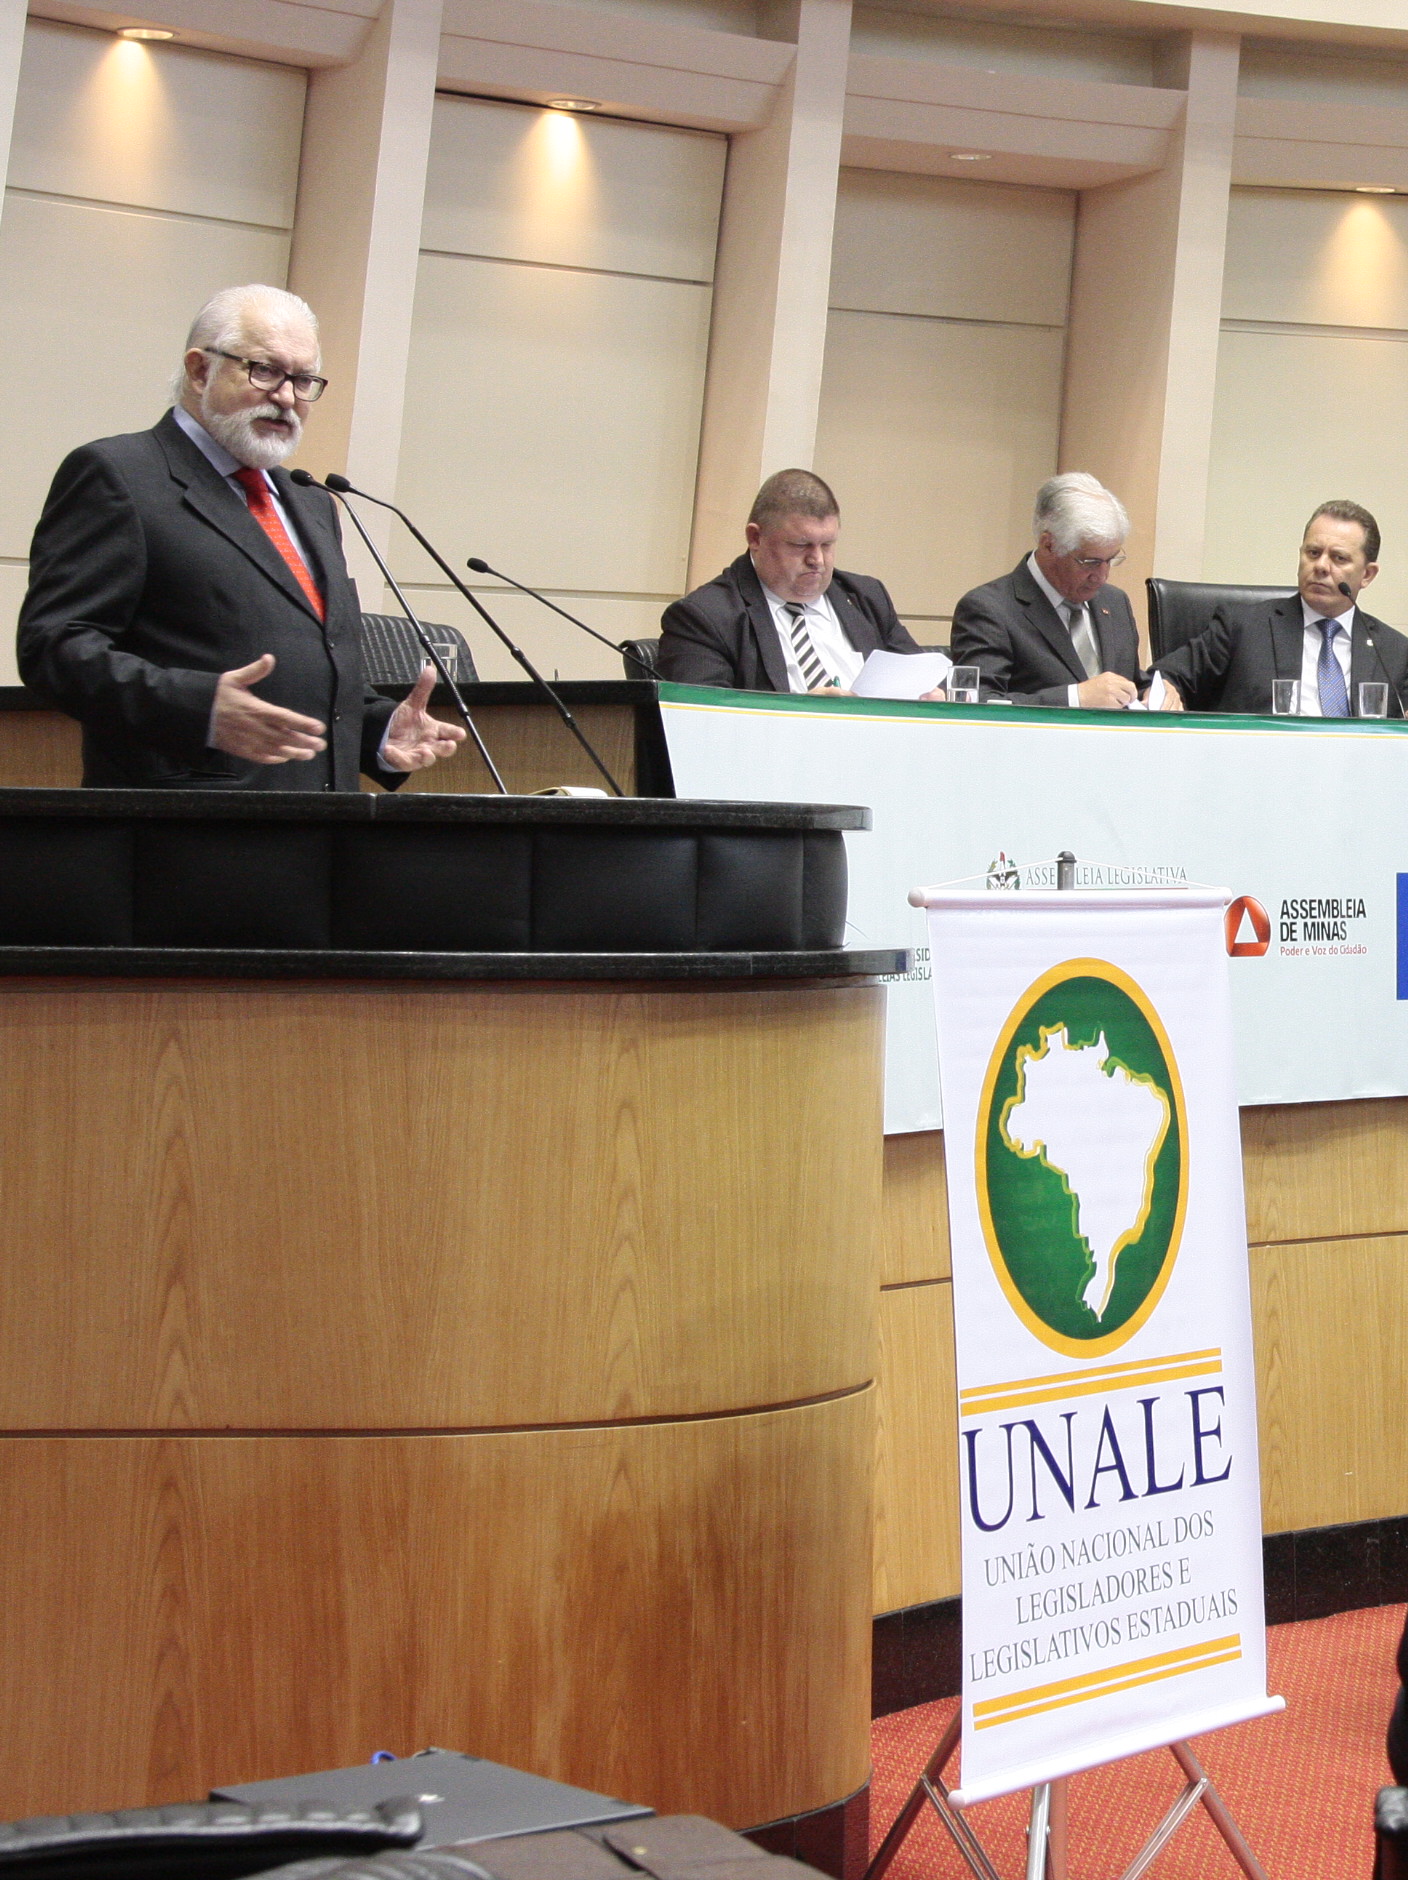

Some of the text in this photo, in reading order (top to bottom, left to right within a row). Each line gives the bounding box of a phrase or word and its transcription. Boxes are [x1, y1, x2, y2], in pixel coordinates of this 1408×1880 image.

[1026, 866, 1188, 886] ASSELEIA LEGISLATIVA
[1280, 898, 1367, 919] ASSEMBLEIA
[1280, 920, 1347, 942] DE MINAS
[1280, 944, 1367, 956] Poder e Voz do Cidadão
[961, 1386, 1233, 1532] UNALE
[984, 1510, 1215, 1587] UNIÃO NACIONAL DOS
[1016, 1557, 1192, 1625] LEGISLADORES E
[970, 1589, 1239, 1683] LEGISLATIVOS ESTADUAIS
